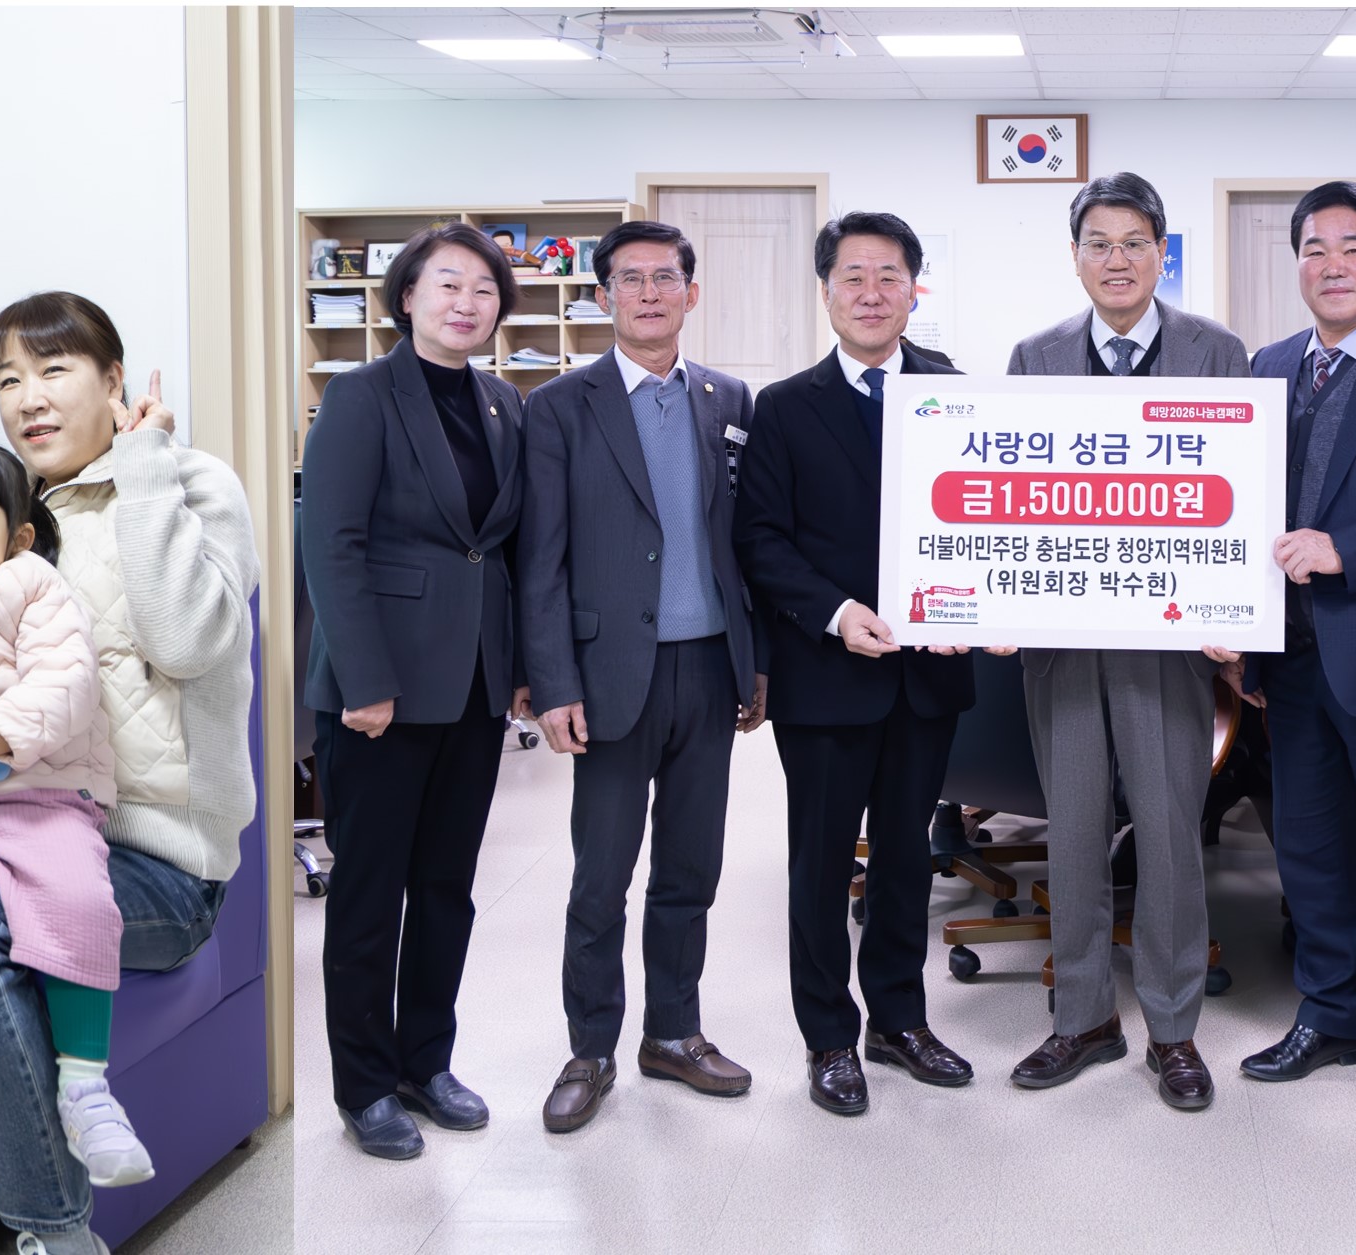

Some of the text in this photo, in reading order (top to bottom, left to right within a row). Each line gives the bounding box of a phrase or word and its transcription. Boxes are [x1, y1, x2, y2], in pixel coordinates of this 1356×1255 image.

[945, 403, 975, 416] 청양군
[1148, 406, 1246, 420] 희망2026나눔캠페인
[961, 431, 1206, 466] 사랑의 성금 기탁
[962, 479, 1204, 519] 금1,500,000원
[918, 534, 1246, 565] 더불어민주당 충남도당 청양지역위원회
[986, 568, 1177, 598] (위원회장 박수현)
[1185, 604, 1254, 619] 사랑의열매
